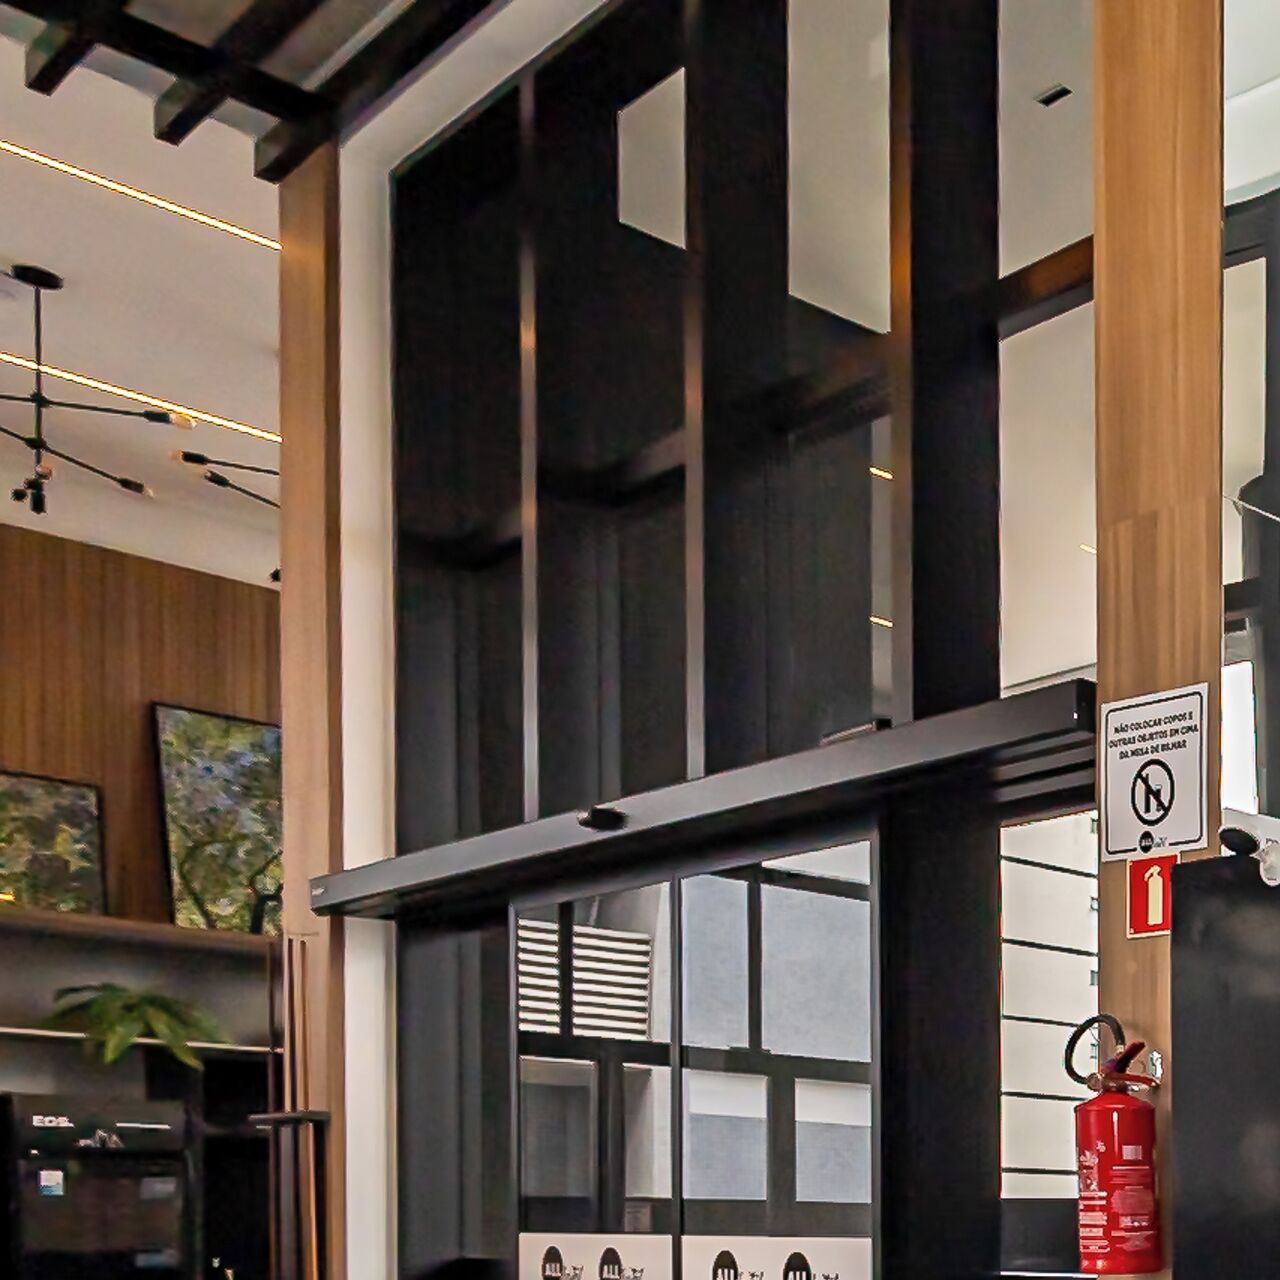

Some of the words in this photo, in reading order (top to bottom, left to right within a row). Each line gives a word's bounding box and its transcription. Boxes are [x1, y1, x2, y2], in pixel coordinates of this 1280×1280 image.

[1130, 718, 1162, 731] COLOCAR
[1163, 712, 1187, 725] COPOS
[1137, 730, 1167, 743] OBJETOS
[1170, 728, 1179, 738] EM
[1180, 724, 1198, 735] CIMA
[1119, 750, 1129, 760] DA
[1131, 746, 1149, 757] MESA
[1150, 744, 1160, 754] DE
